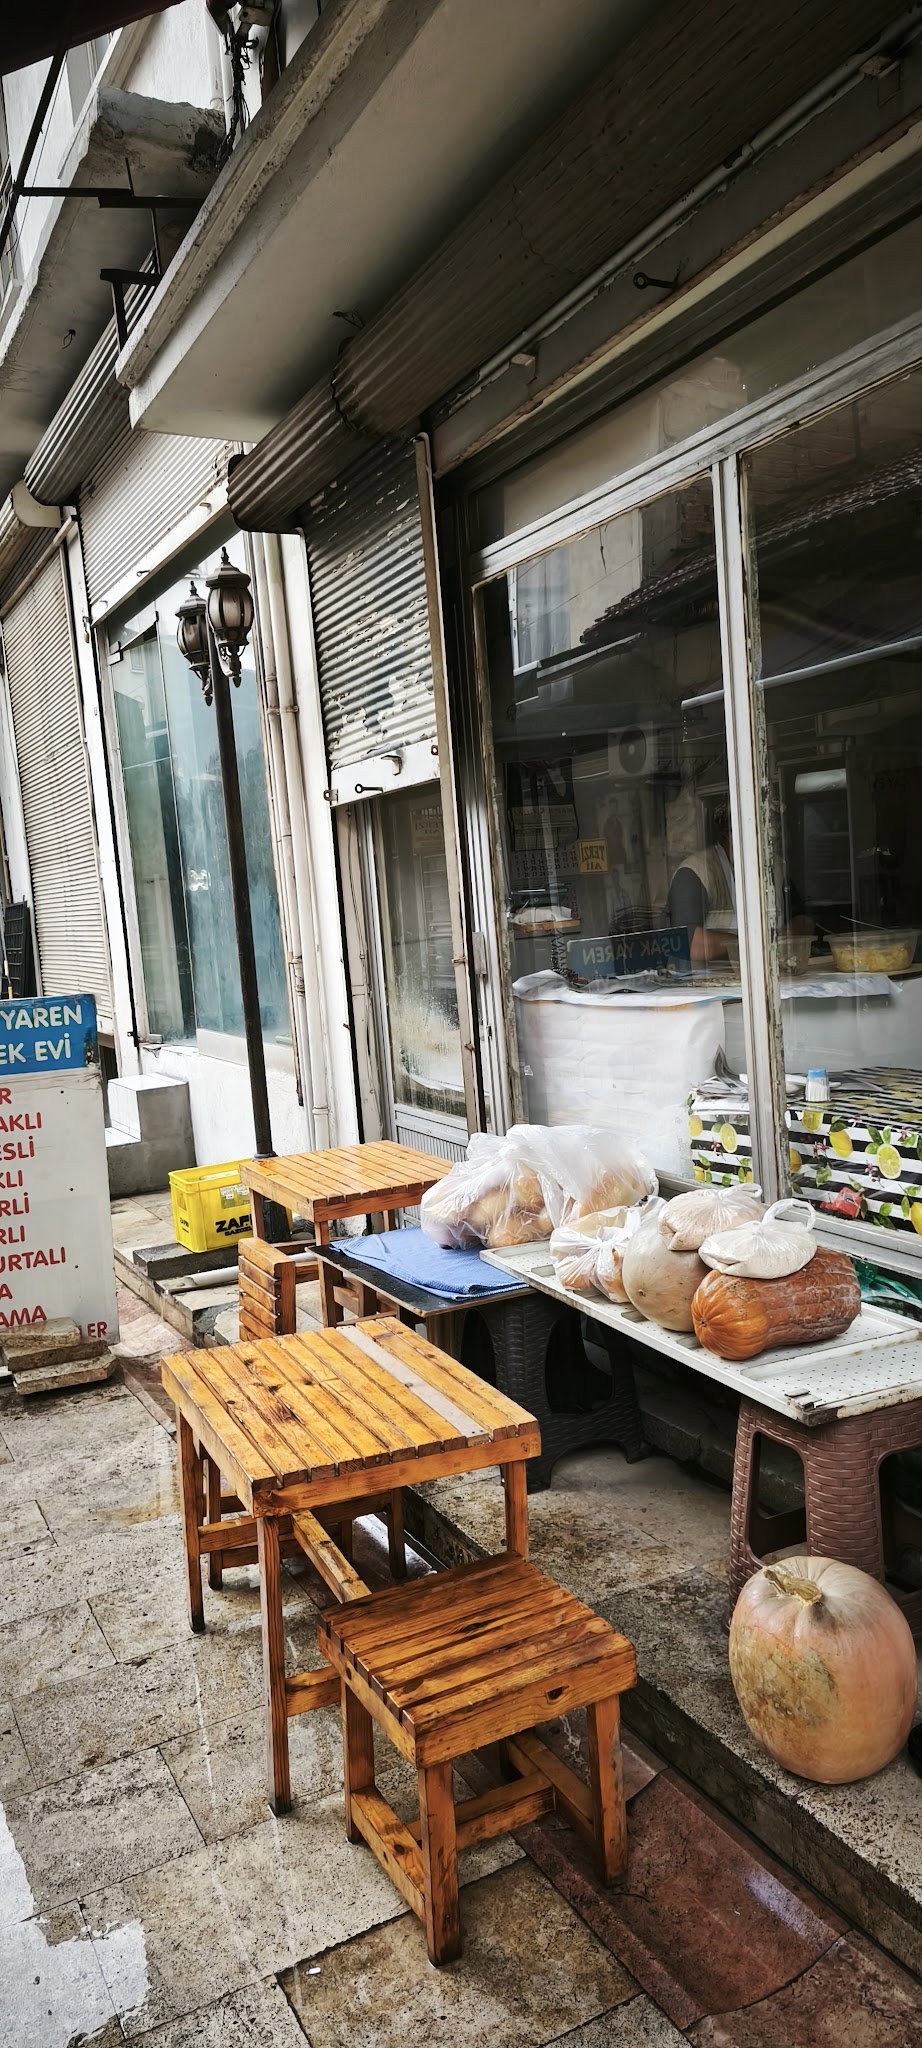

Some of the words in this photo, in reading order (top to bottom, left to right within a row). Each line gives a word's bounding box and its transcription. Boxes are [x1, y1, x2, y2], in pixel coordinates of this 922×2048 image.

[0, 1004, 82, 1030] YAREN
[34, 1032, 71, 1062] EVİ
[0, 1136, 35, 1161] SLİ
[215, 1213, 253, 1233] ZAF
[79, 1321, 108, 1338] ER
